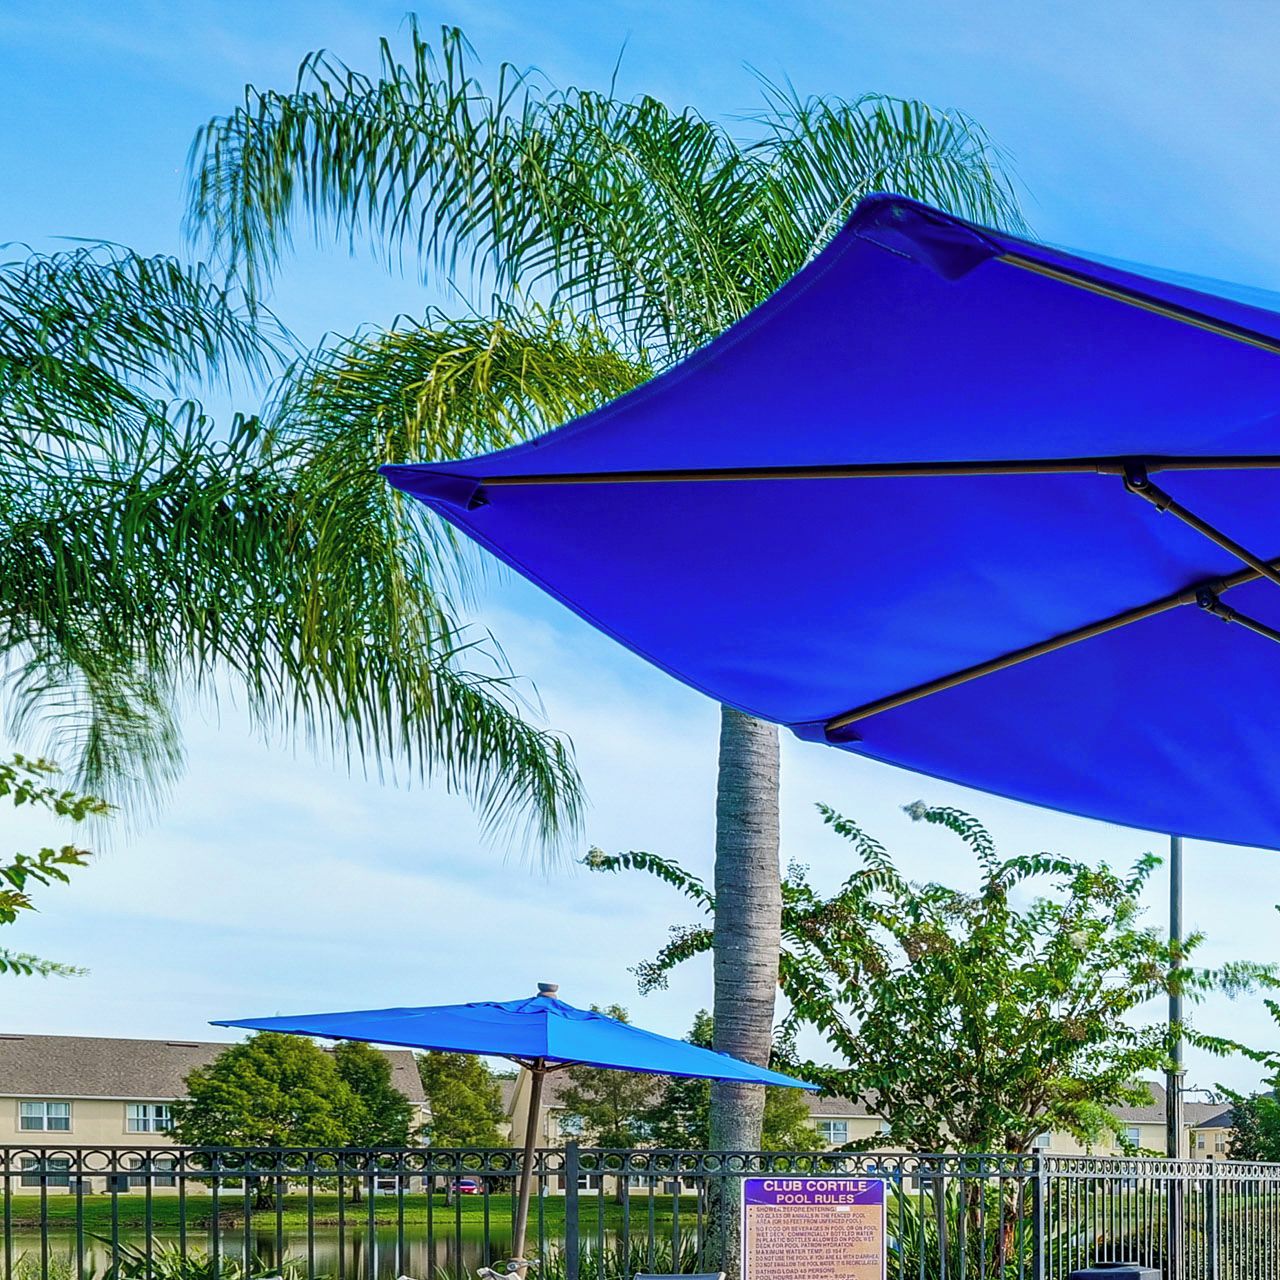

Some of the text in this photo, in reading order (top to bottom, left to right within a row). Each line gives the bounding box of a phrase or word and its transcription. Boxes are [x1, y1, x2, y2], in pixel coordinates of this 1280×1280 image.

[763, 1180, 867, 1192] CLUB CORTILE
[776, 1194, 854, 1204] POOL RULES
